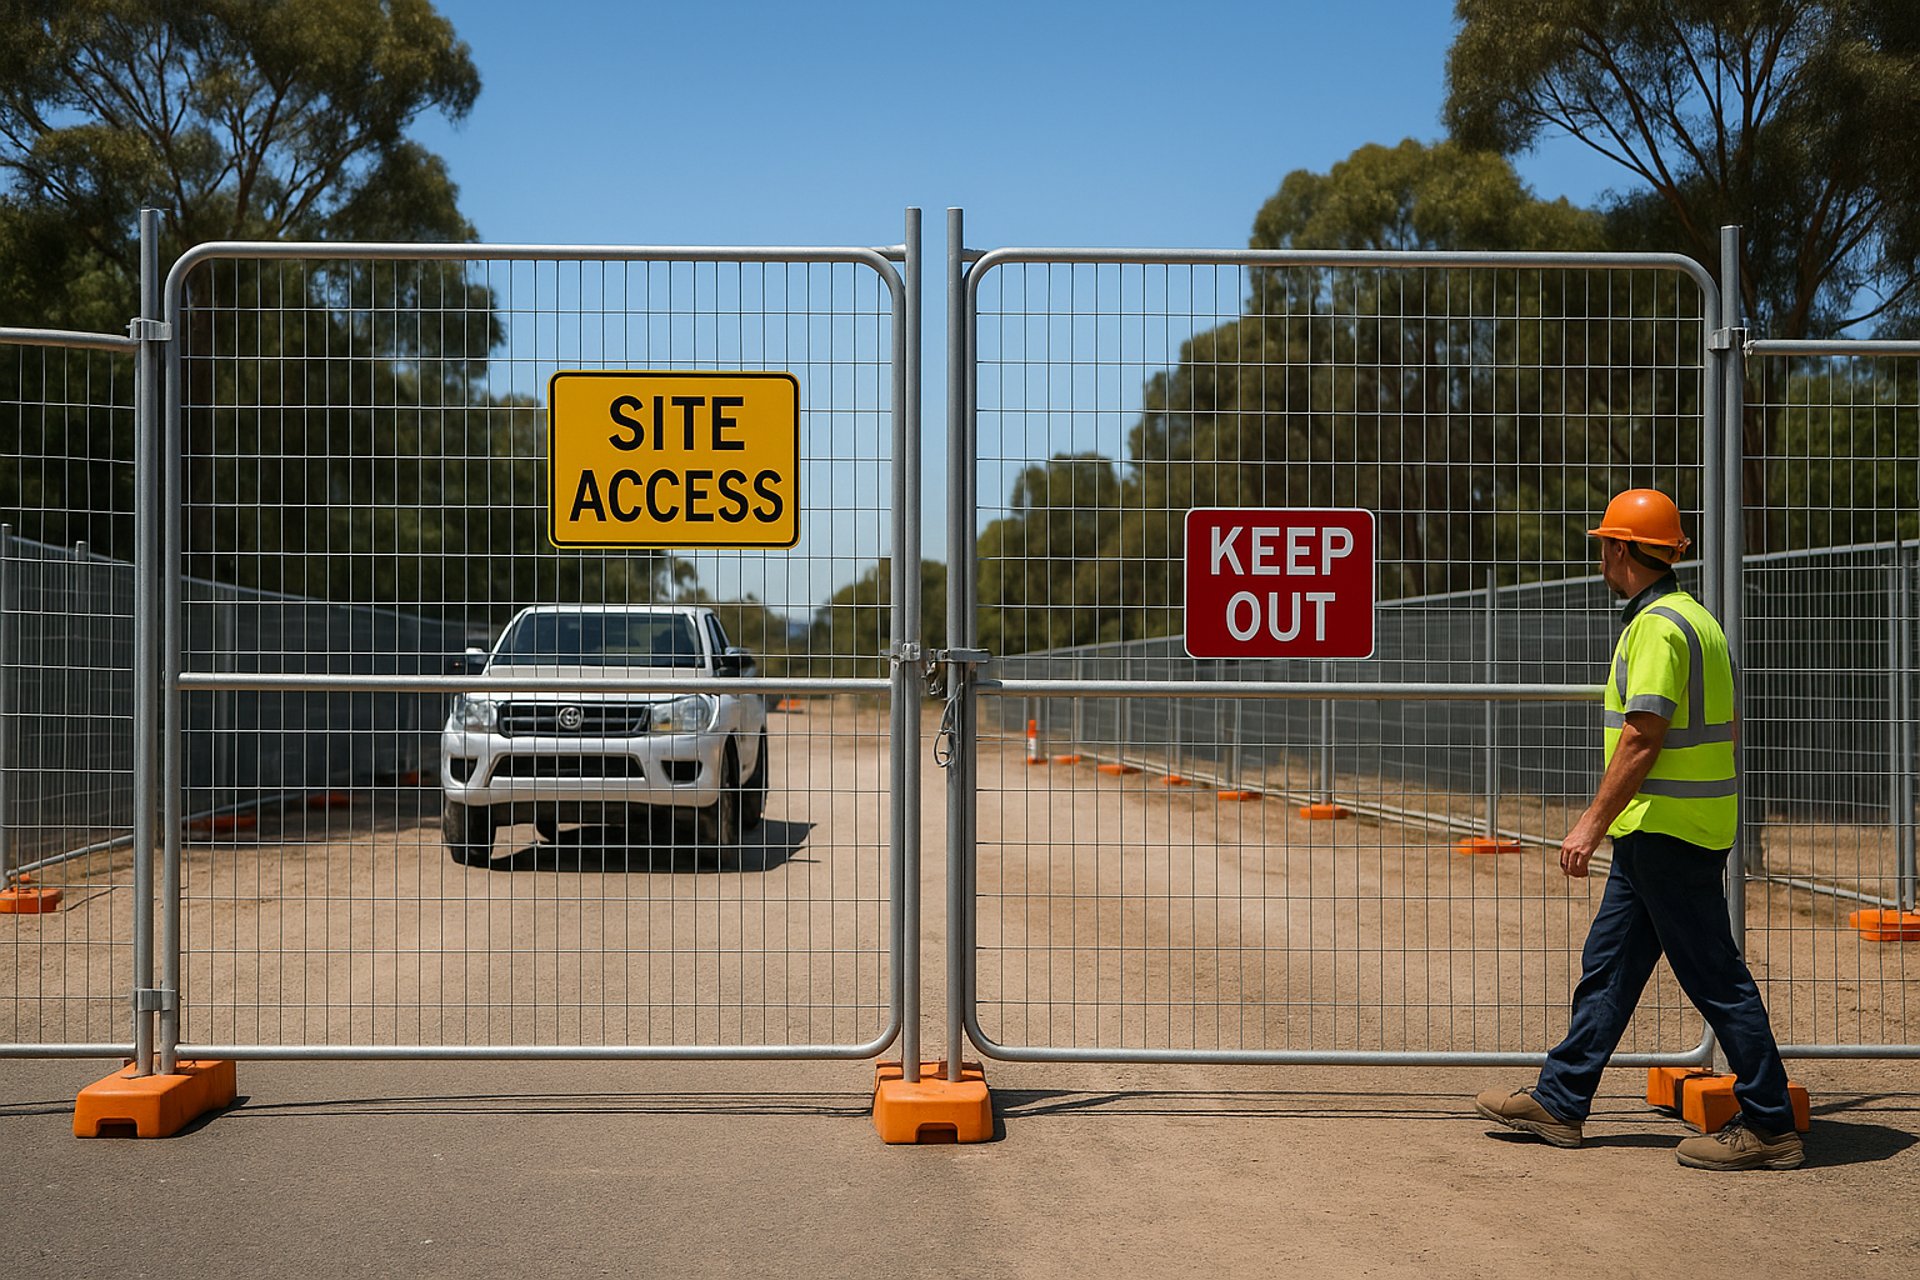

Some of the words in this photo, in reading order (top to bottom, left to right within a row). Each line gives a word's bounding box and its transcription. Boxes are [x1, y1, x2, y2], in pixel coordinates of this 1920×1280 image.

[609, 395, 744, 451] SITE
[570, 469, 783, 523] ACCESS
[1210, 526, 1354, 576] KEEP
[1226, 590, 1336, 642] OUT
